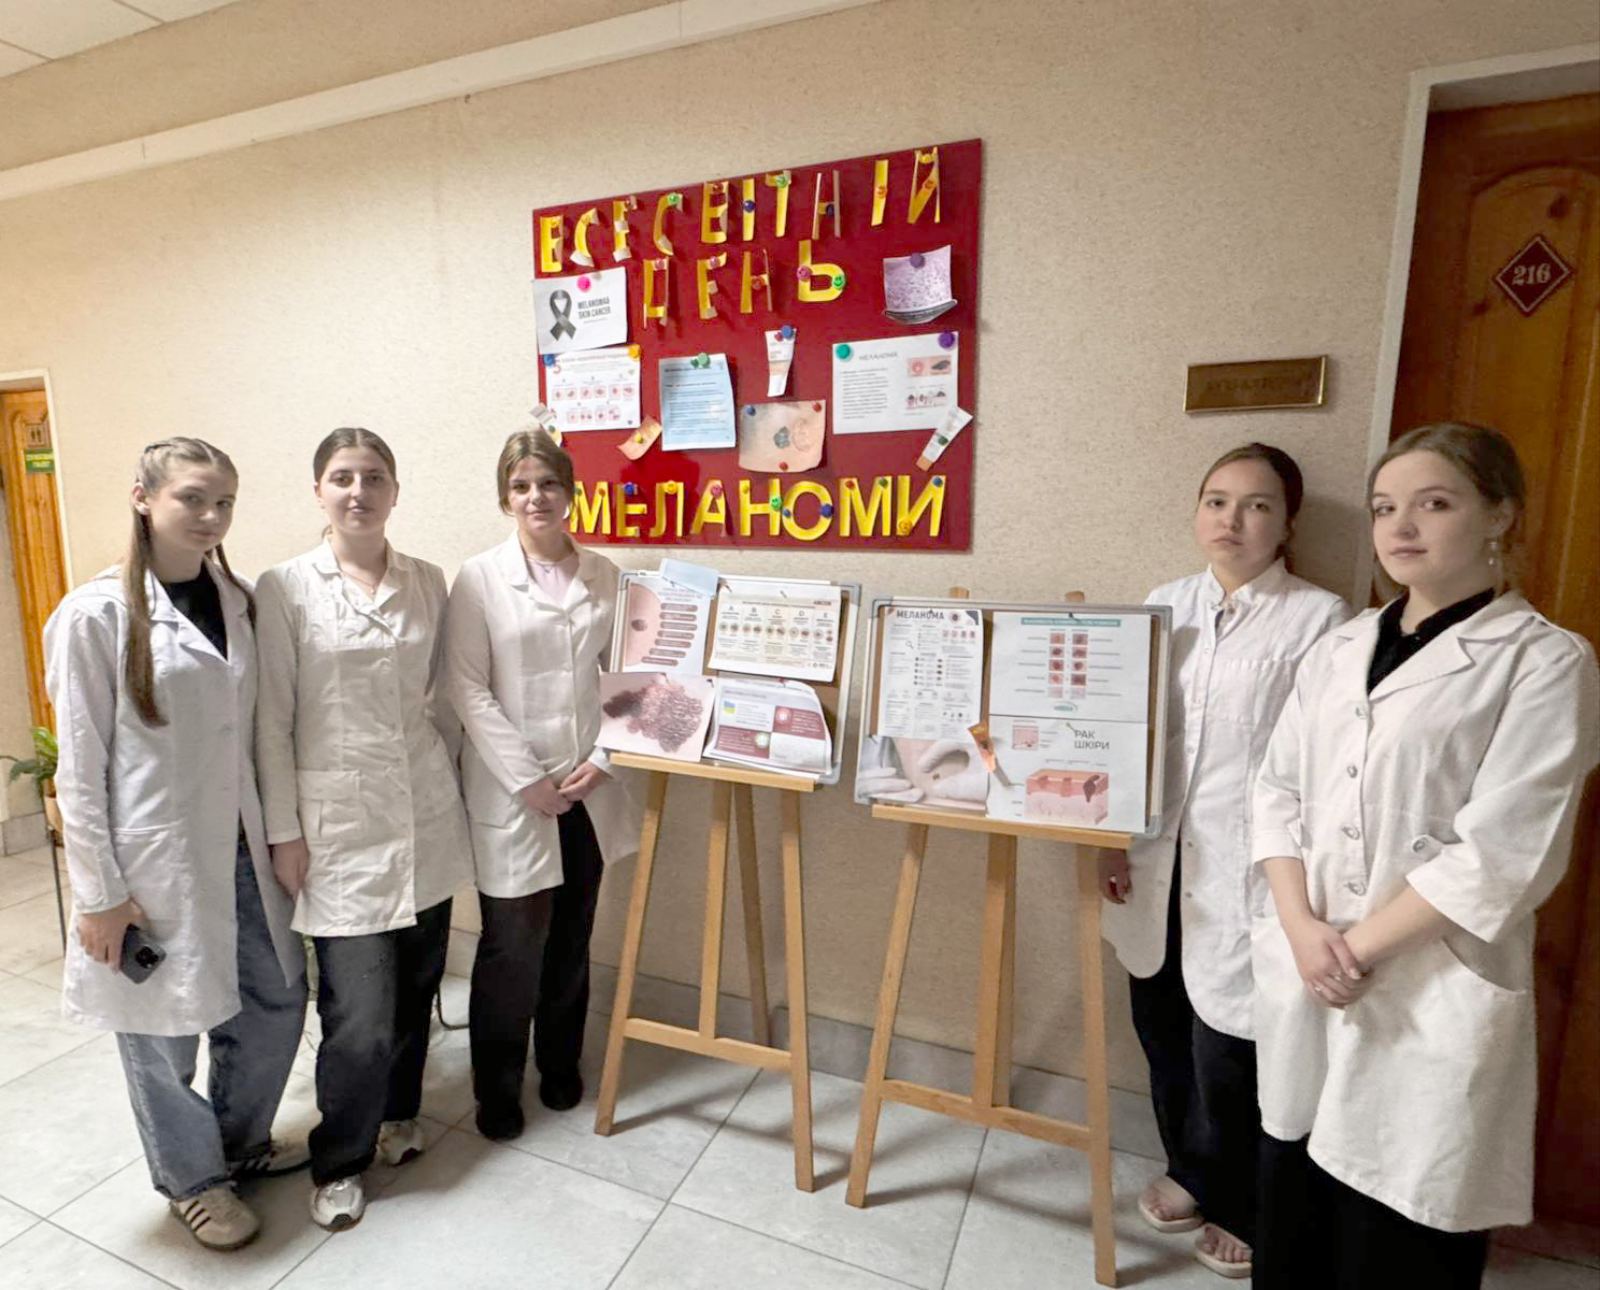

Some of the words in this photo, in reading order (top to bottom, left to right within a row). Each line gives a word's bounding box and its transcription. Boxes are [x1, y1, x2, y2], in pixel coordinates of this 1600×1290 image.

[1512, 263, 1551, 286] 216
[643, 239, 846, 330] ДЕНЬ
[570, 474, 946, 541] МЕЛАНОМИ
[896, 609, 945, 620] МЕЛАНОМА
[1074, 729, 1096, 739] РАК
[1074, 741, 1110, 750] ШКІРИ
